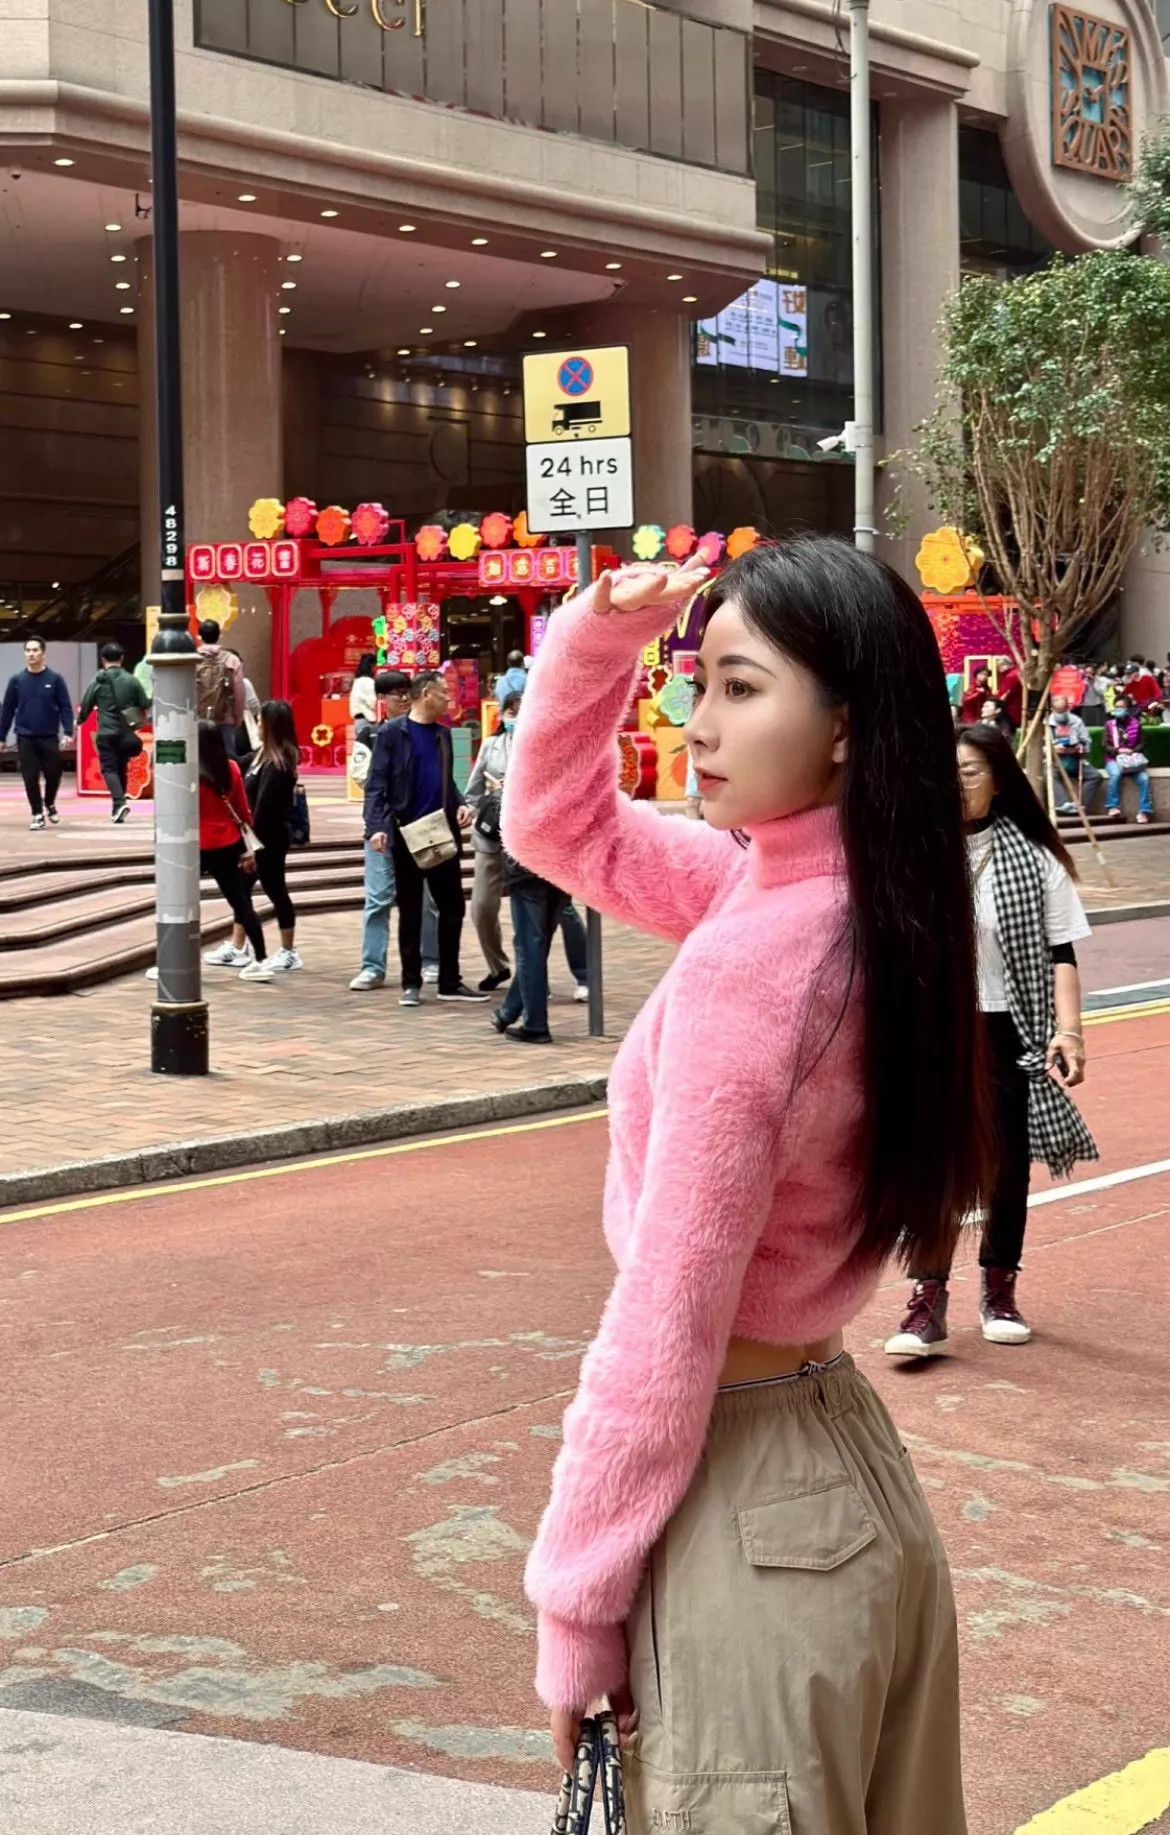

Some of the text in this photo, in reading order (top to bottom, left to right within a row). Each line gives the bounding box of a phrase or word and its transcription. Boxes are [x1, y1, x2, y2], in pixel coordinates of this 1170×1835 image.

[540, 455, 618, 478] 24 hrs
[549, 486, 608, 517] 全日
[165, 504, 177, 567] 48298
